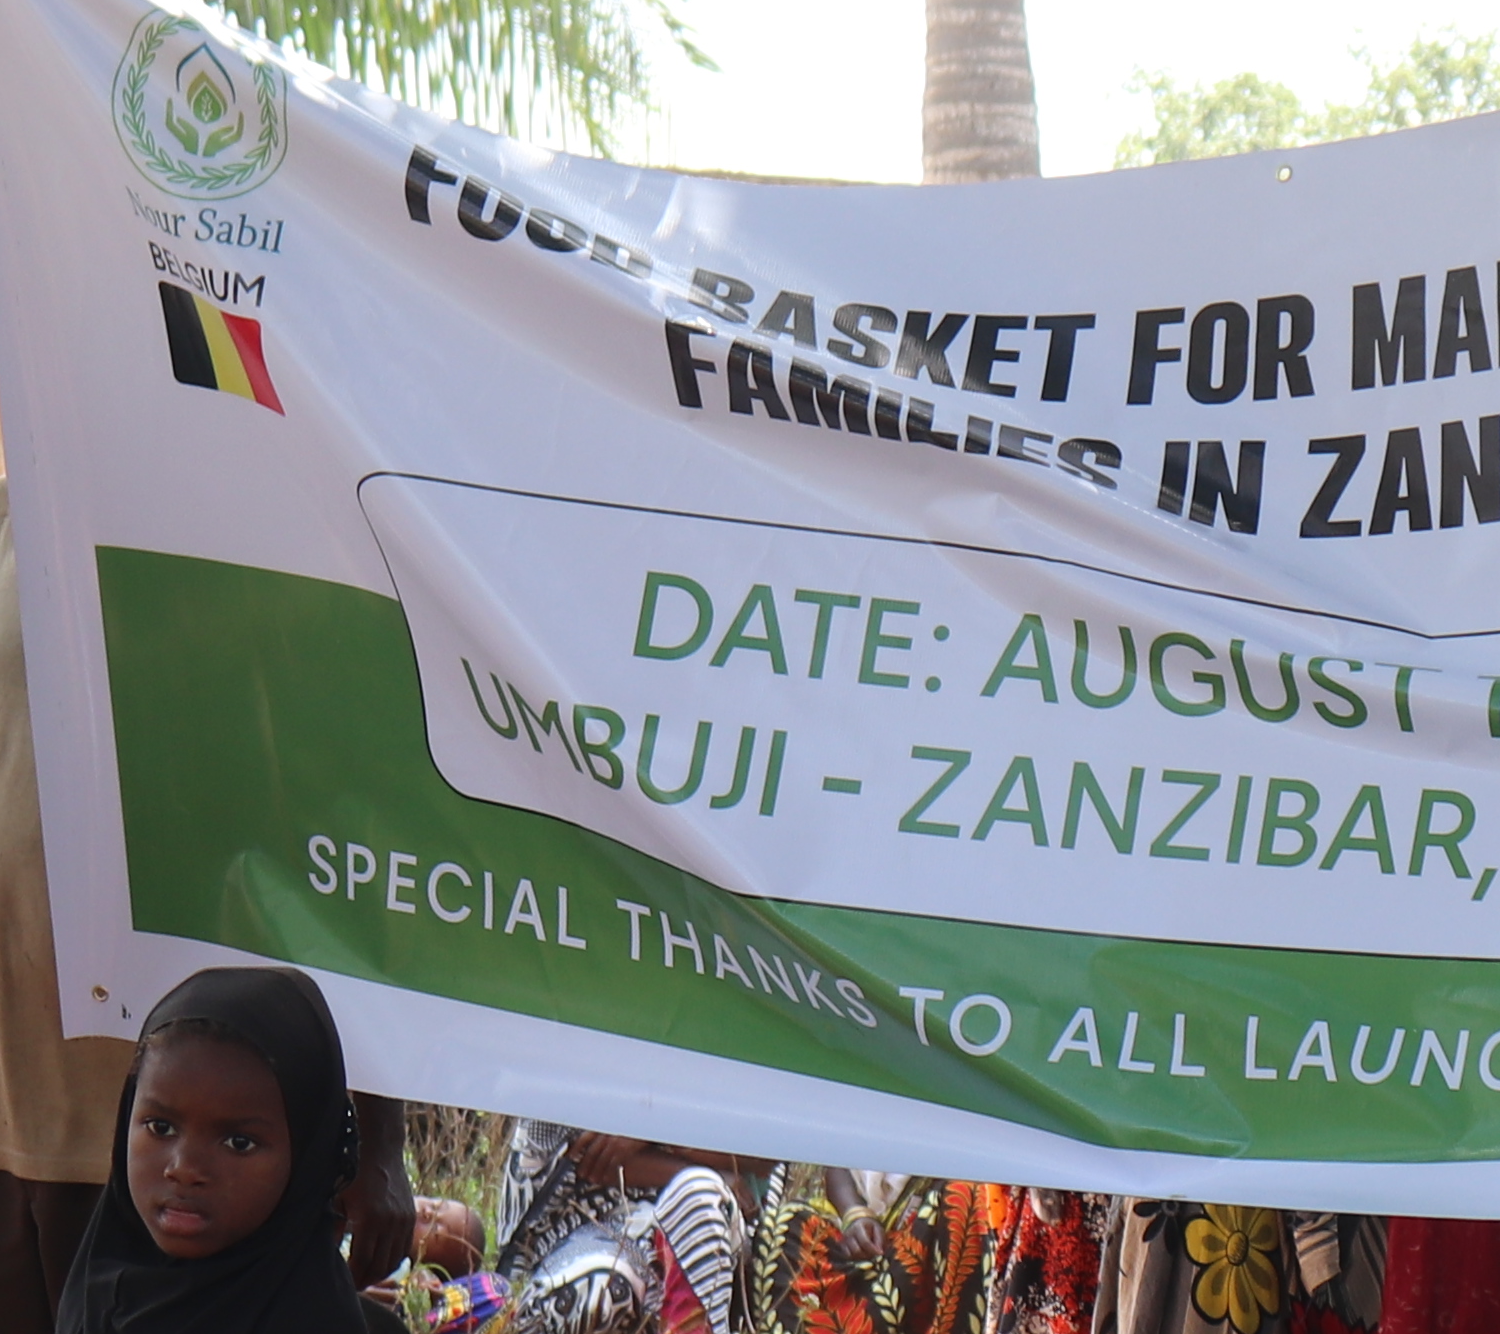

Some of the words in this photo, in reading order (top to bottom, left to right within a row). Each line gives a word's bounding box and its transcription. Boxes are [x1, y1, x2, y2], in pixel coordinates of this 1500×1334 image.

[125, 185, 186, 238] Nour
[194, 207, 285, 254] Sabil
[148, 240, 266, 308] BELGIUM
[404, 143, 654, 279] FOOD
[687, 267, 1096, 402] BASKET
[1126, 294, 1316, 406] FOR
[664, 317, 1123, 491] FAMILIES
[1155, 439, 1267, 536] IN
[633, 571, 951, 693] DATE:
[980, 612, 1445, 733] AUGUST
[460, 657, 789, 817] UMBUJI
[822, 776, 863, 795] -
[897, 745, 1499, 901] ZANZIBAR,
[306, 834, 588, 951] SPECIAL
[615, 898, 878, 1030] THANKS
[899, 986, 1013, 1057] TO
[1047, 1007, 1208, 1080] ALL
